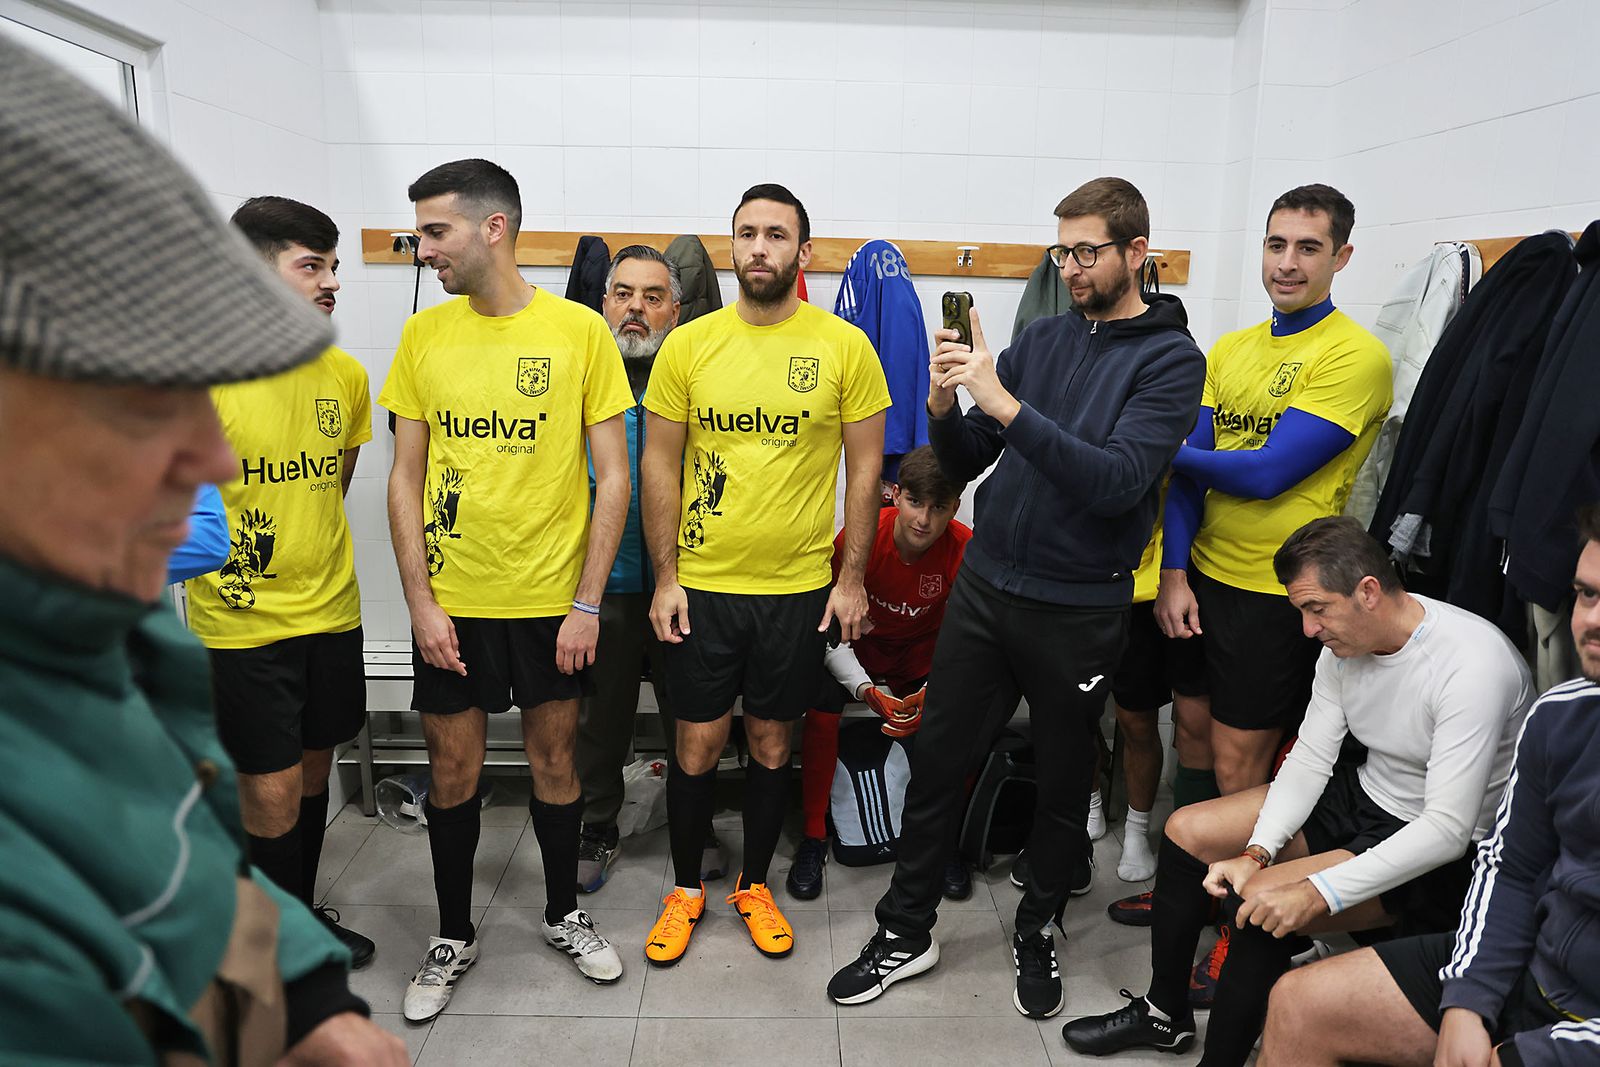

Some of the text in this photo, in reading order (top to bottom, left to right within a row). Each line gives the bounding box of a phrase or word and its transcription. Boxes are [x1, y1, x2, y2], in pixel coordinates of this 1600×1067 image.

[437, 410, 536, 441] Huelva
[697, 407, 799, 435] Huelva
[496, 443, 536, 455] original
[761, 437, 798, 448] original
[242, 451, 338, 486] Huelva
[310, 479, 337, 492] origina
[1152, 1022, 1171, 1034] COPA
